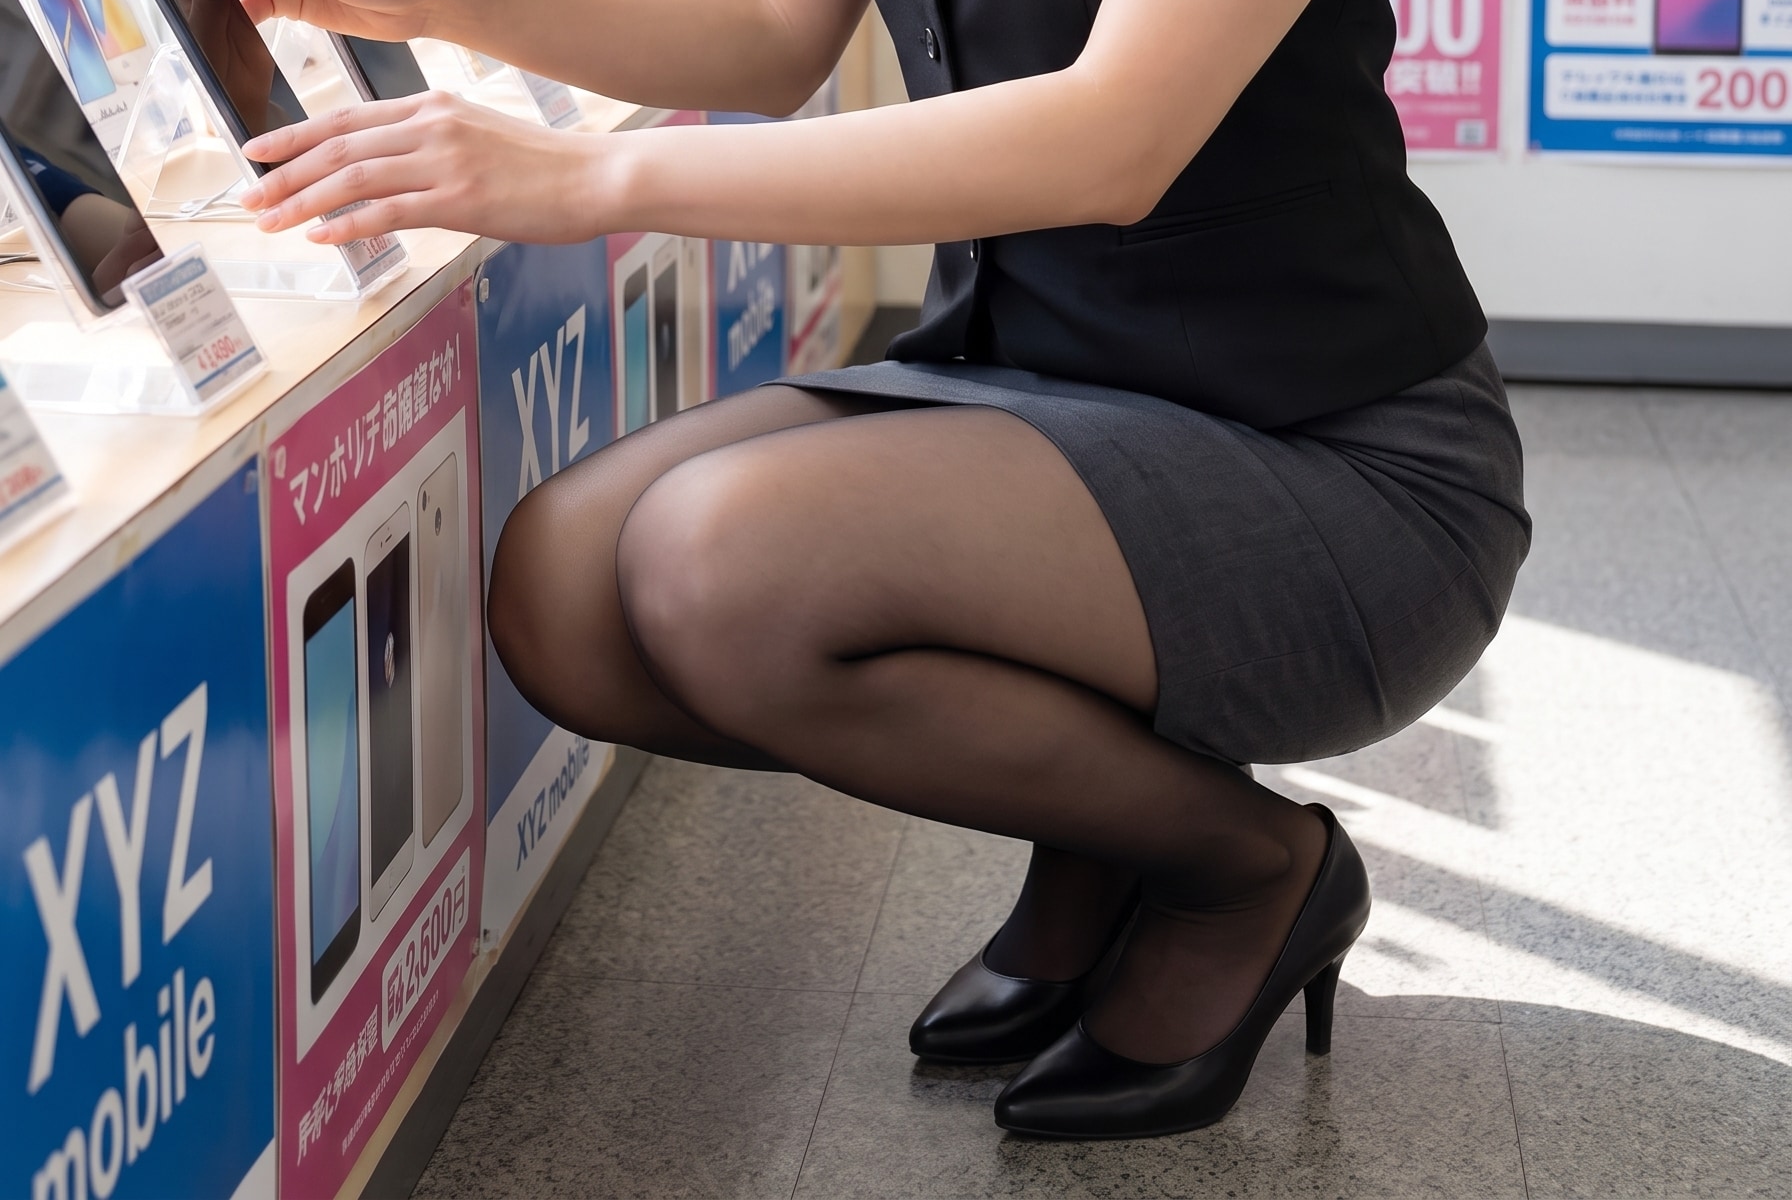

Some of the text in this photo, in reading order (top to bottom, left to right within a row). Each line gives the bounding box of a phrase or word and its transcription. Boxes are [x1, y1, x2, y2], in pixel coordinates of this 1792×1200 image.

[511, 303, 590, 500] XYZ
[22, 680, 213, 1097] XYZ
[516, 736, 590, 872] XYZ mobile
[32, 966, 216, 1200] mobile
